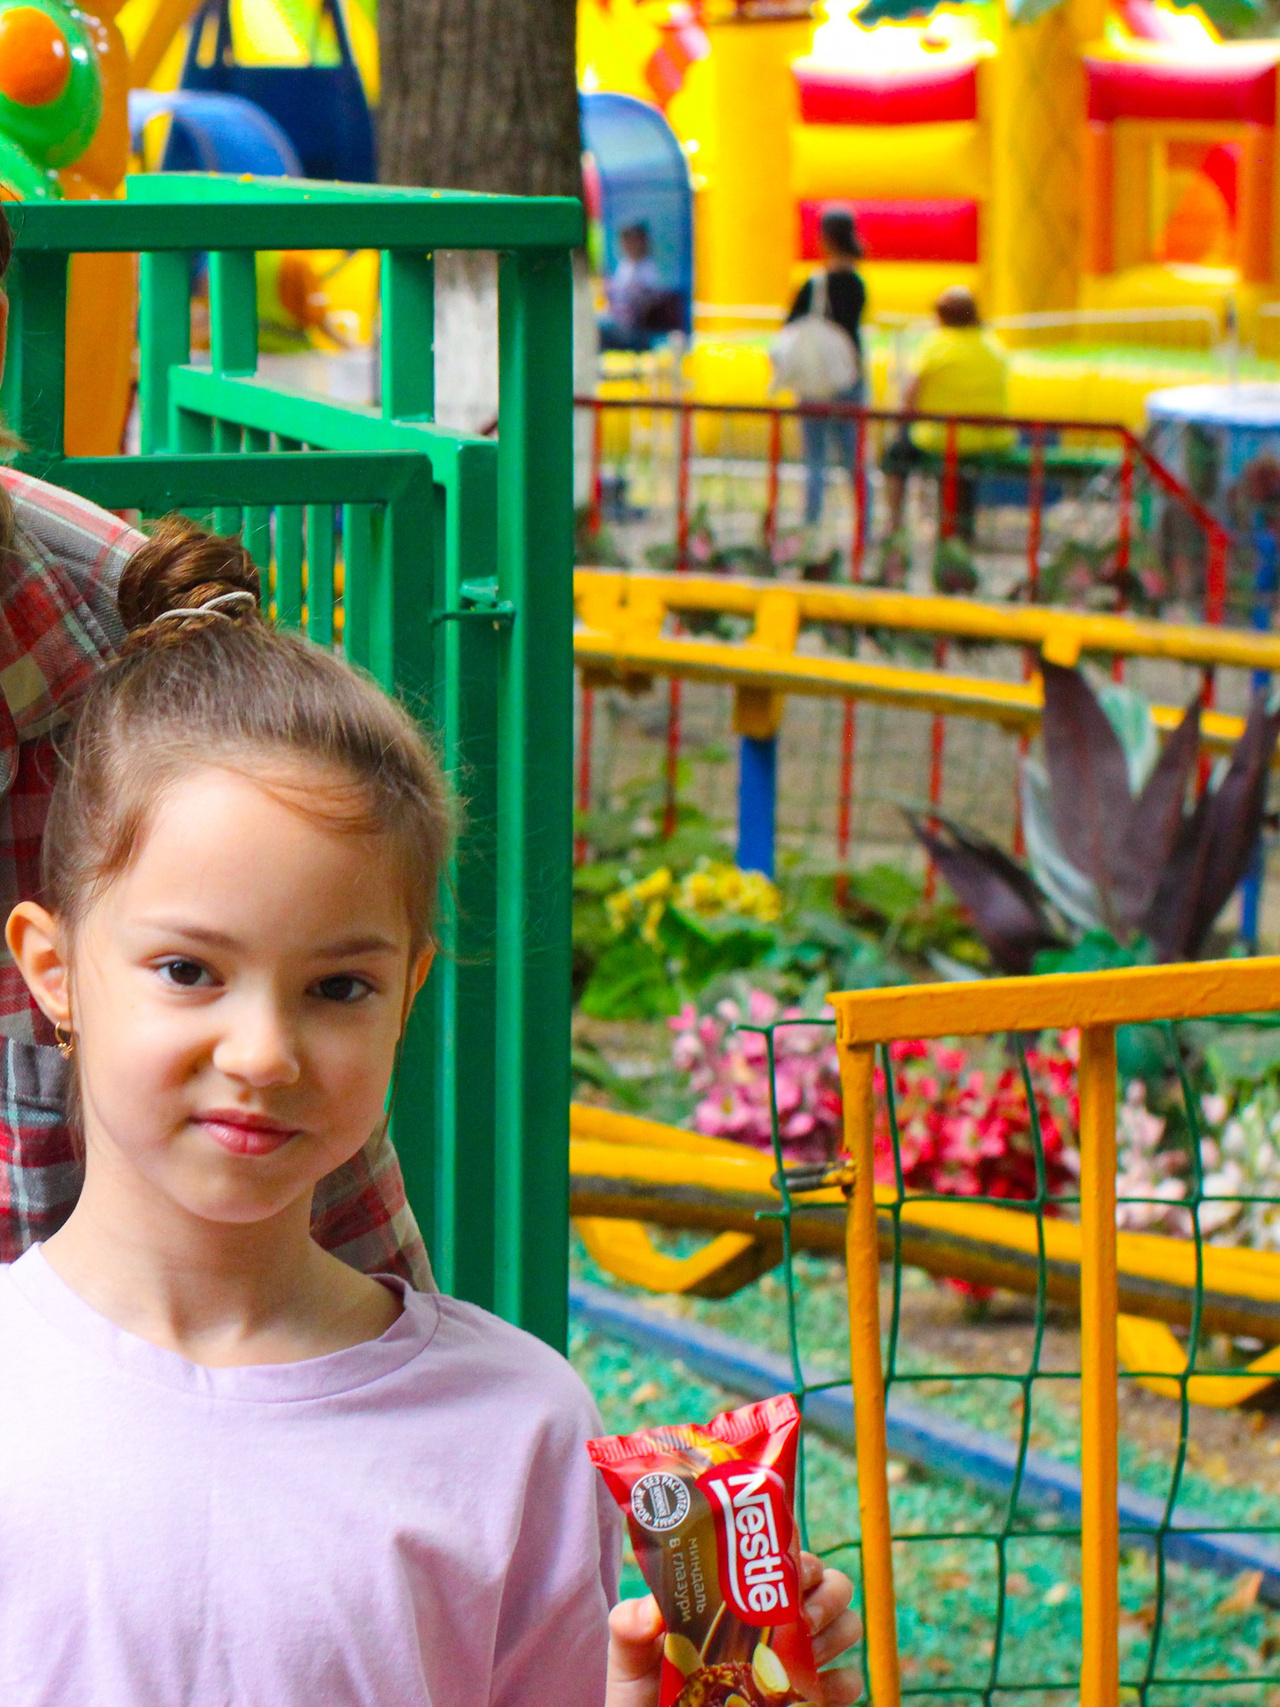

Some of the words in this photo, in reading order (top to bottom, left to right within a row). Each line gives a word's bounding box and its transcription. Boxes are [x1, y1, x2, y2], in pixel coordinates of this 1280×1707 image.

[642, 1475, 661, 1489] БЕЗ
[671, 1552, 691, 1623] глазури
[688, 1537, 705, 1614] миндаль
